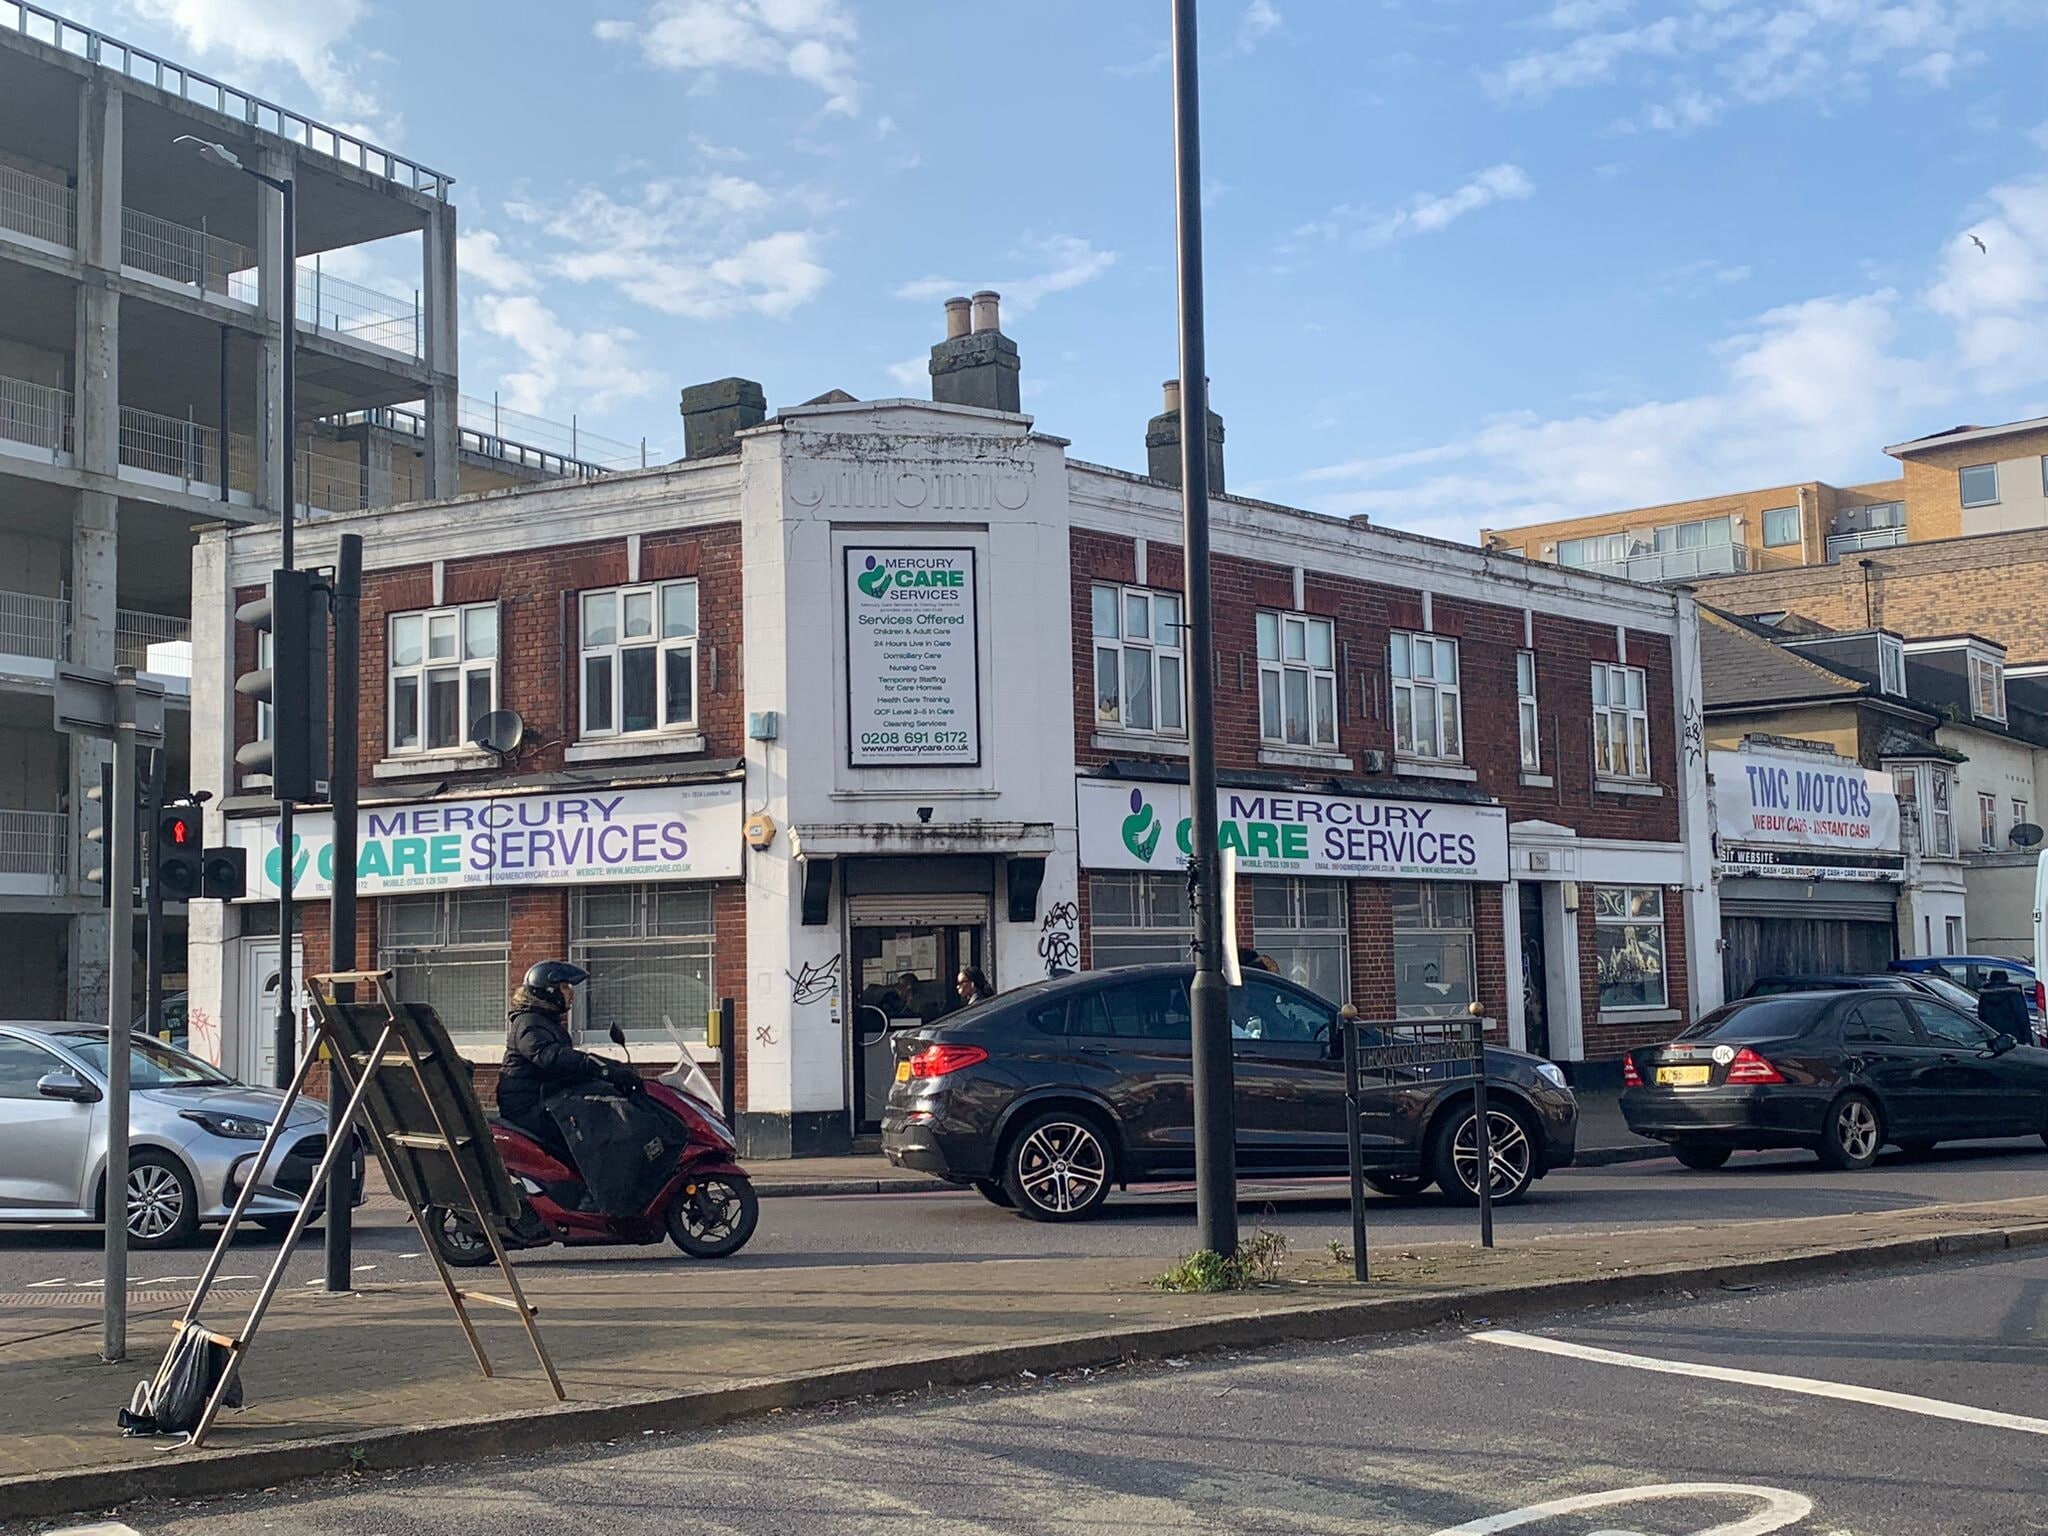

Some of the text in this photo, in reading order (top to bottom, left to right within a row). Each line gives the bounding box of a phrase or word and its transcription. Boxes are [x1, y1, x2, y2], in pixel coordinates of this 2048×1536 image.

[885, 558, 954, 569] MERCURY
[894, 570, 965, 588] CARE
[890, 589, 959, 600] SERVICES
[858, 614, 965, 625] Services Offered
[883, 652, 923, 660] Domiciliary
[889, 664, 918, 672] Nursing
[878, 676, 947, 684] Temporary Staffing
[922, 696, 950, 704] Training
[861, 731, 968, 744] 0208 691 6172
[861, 744, 969, 755] www.mercurycare.co.uk
[1745, 766, 1871, 818] TMC MOTORS
[368, 796, 625, 837] MERCURY
[1230, 795, 1433, 828] MERCURY
[1752, 814, 1765, 830] WE
[1766, 815, 1786, 831] BUY
[1786, 817, 1808, 833] CARS
[1813, 820, 1849, 837] INSTANT
[1849, 823, 1870, 839] CASH
[469, 821, 688, 870] SERVICES
[1324, 827, 1476, 865] SERVICES
[1737, 851, 1774, 863] WEBSITE
[1781, 867, 1795, 875] CARS
[1827, 869, 1840, 877] CASH
[1844, 869, 1857, 878] CARS
[1715, 1049, 1730, 1060] UK
